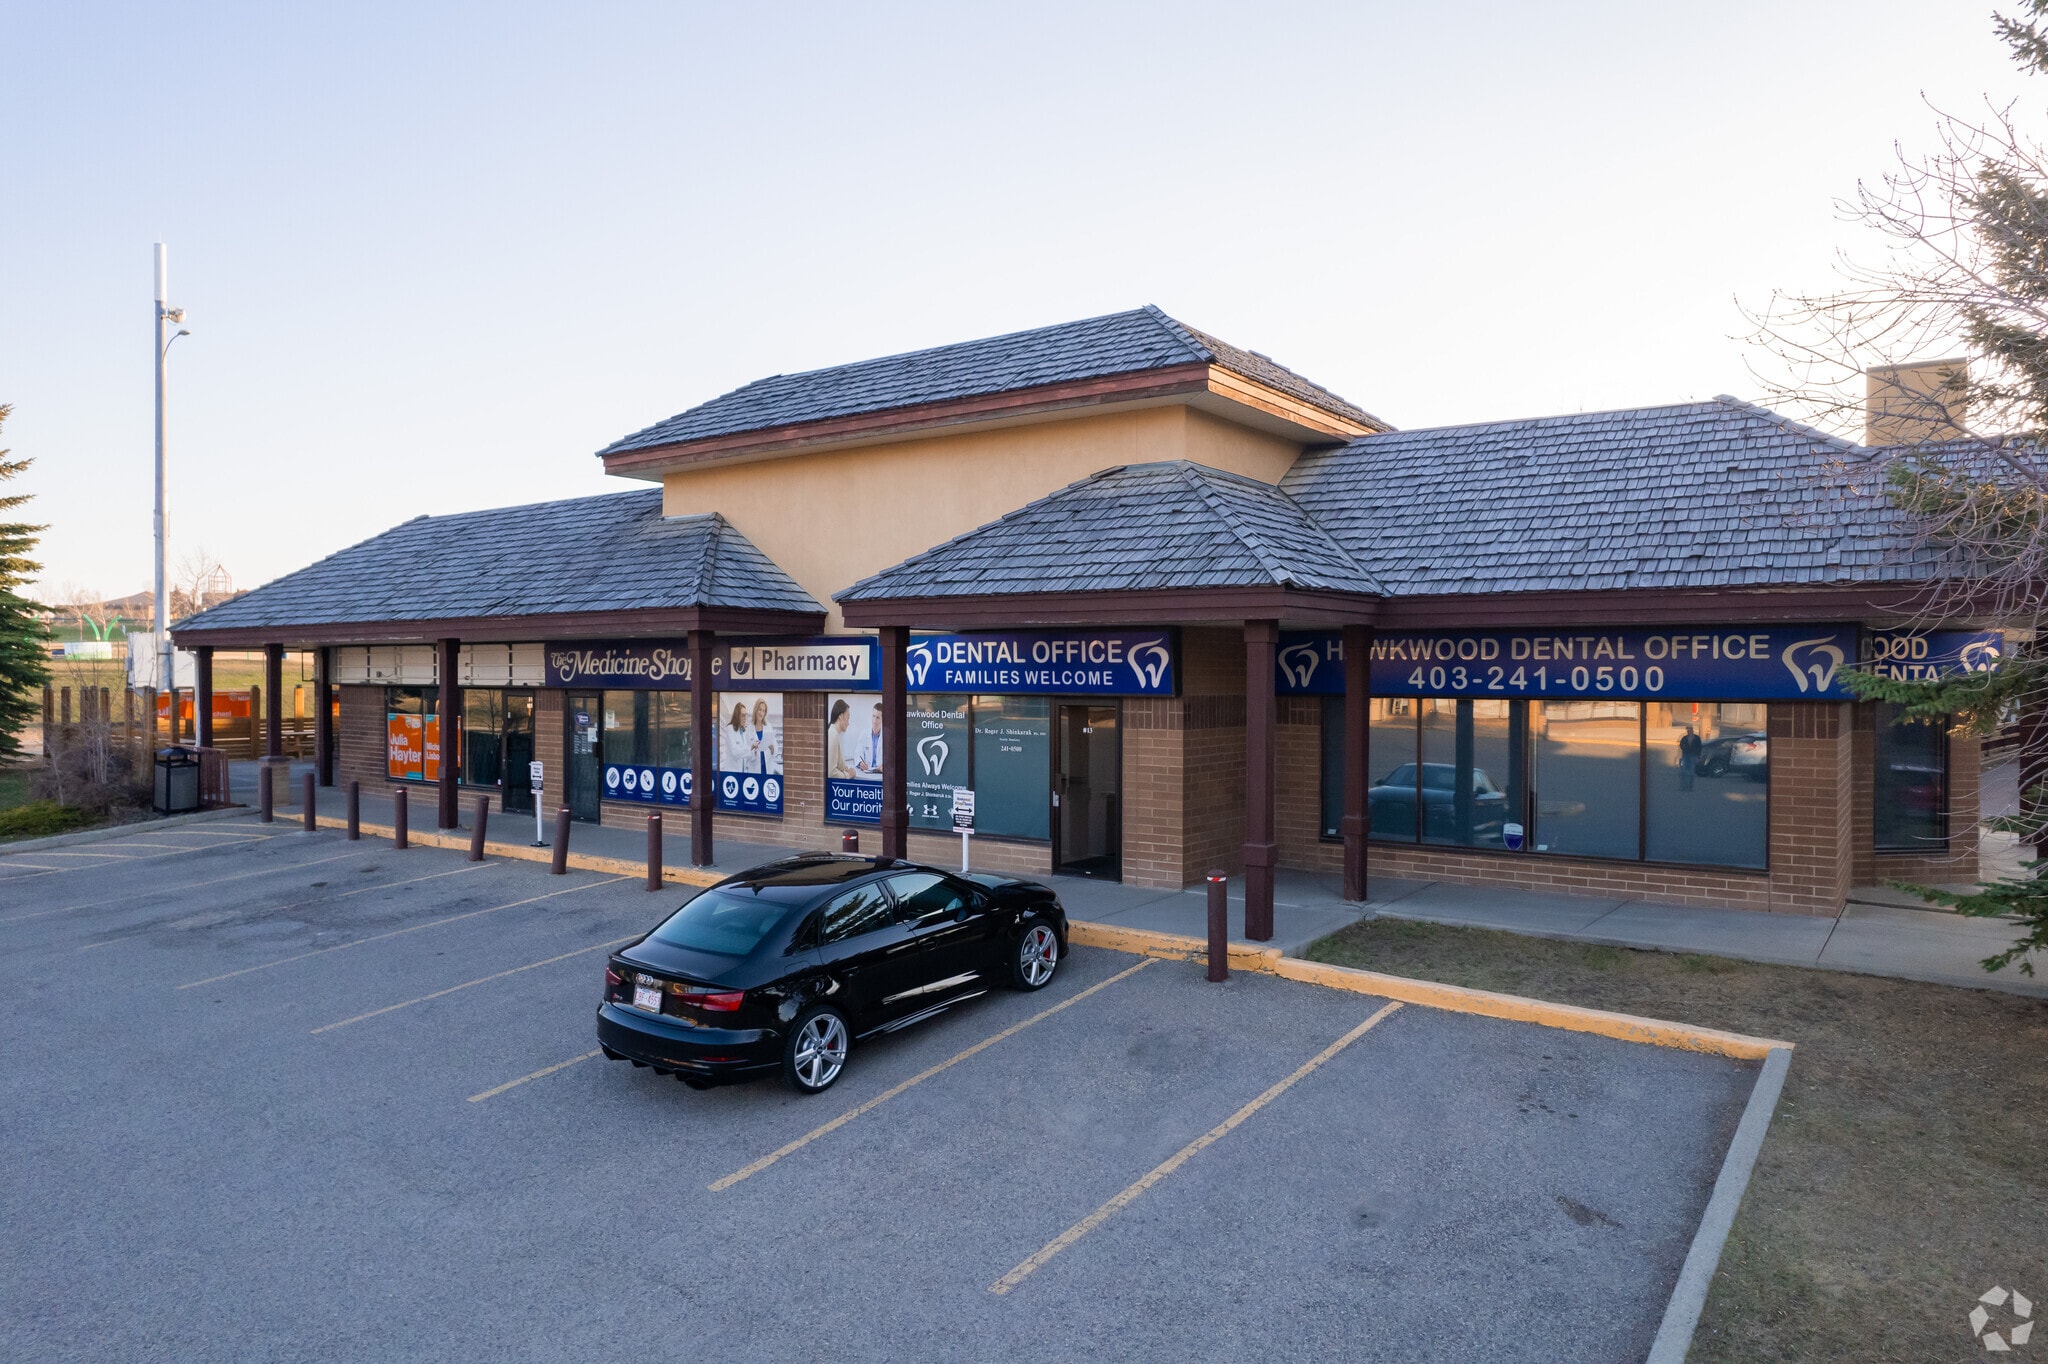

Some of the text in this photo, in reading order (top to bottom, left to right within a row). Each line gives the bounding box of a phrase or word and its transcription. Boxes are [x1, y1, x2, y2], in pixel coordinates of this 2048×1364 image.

[936, 640, 1123, 664] DENTAL OFFICE
[1326, 634, 1770, 661] HWKWOOD DENTAL OFFICE
[551, 649, 723, 682] The Medicine Shoe
[761, 650, 861, 677] Pharmacy
[945, 669, 1113, 686] FAMILIES WELCOME
[1407, 665, 1664, 691] 403-241-0500
[1874, 664, 1941, 684] ENTA
[906, 710, 965, 719] awkwood Dental
[921, 720, 944, 729] Office
[391, 733, 408, 746] Julia
[391, 745, 421, 765] Hayter
[832, 785, 855, 798] Your
[922, 782, 941, 791] Always
[832, 798, 883, 814] Our priorit
